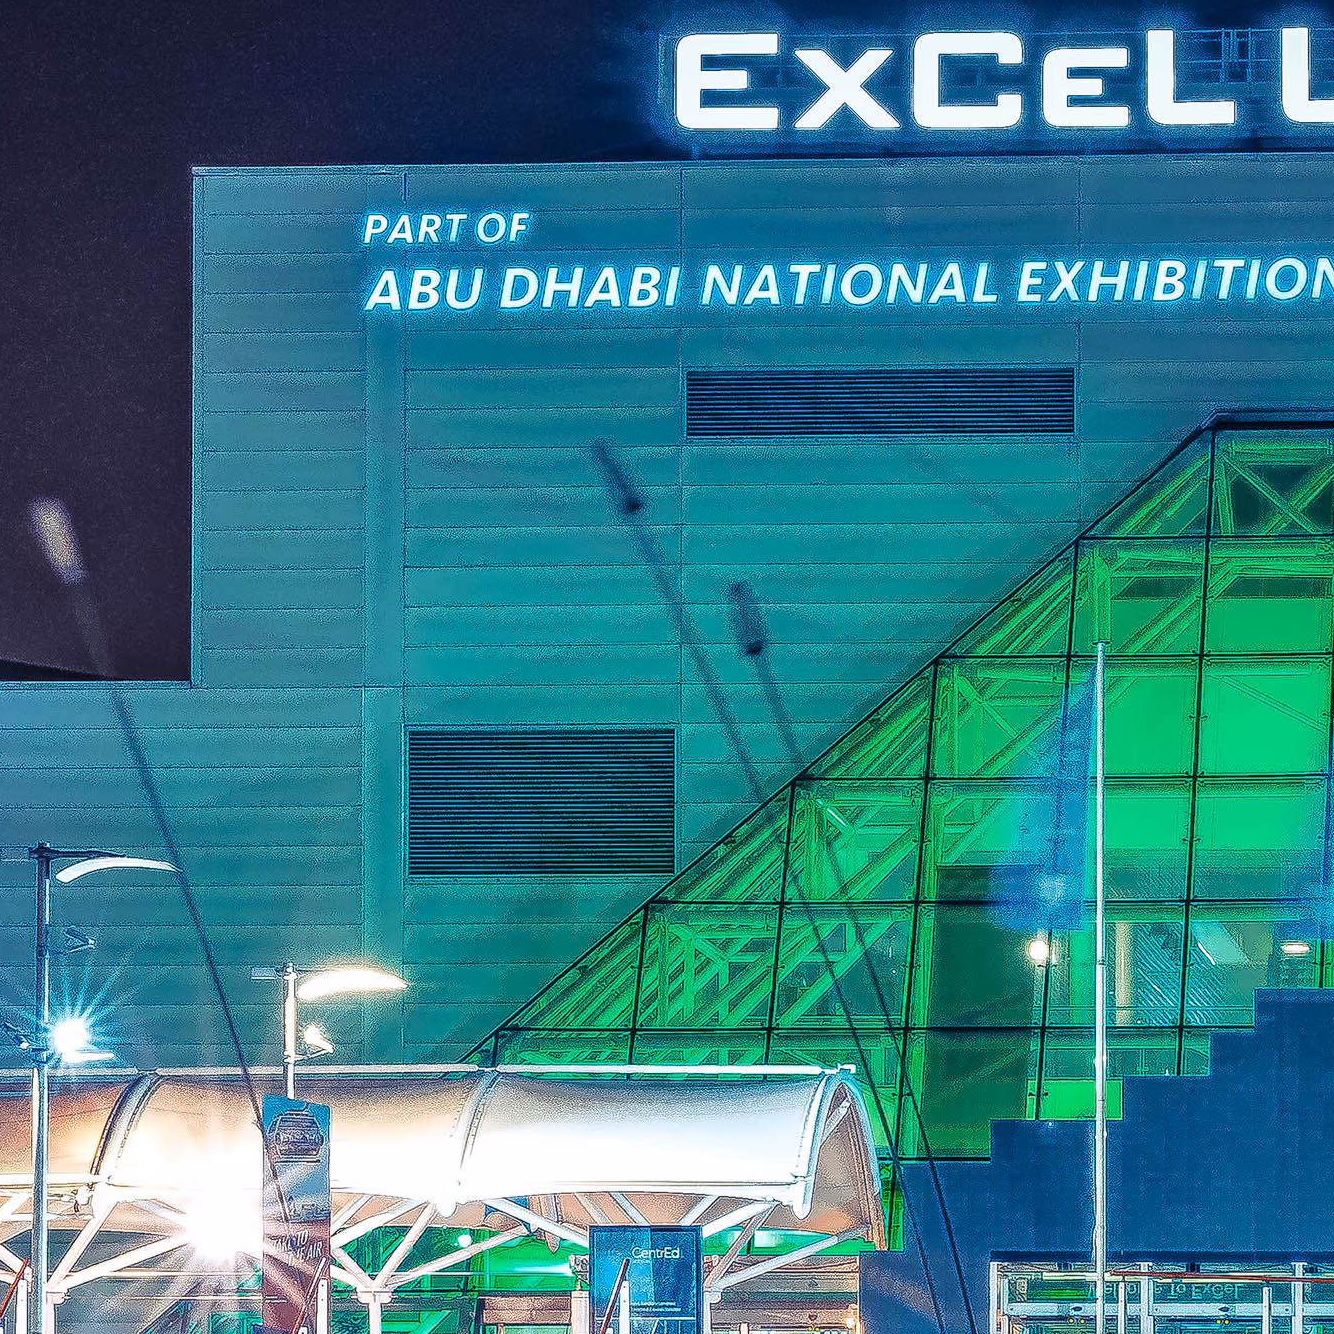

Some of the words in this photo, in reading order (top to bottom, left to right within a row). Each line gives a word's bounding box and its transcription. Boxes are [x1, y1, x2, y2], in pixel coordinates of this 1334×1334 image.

[363, 214, 467, 243] PART
[477, 212, 529, 242] OF
[364, 268, 483, 310] ABU
[499, 267, 680, 308] DHABI
[701, 264, 997, 306] NATIONAL
[307, 1240, 324, 1261] AIR
[631, 1246, 681, 1259] CentrEd
